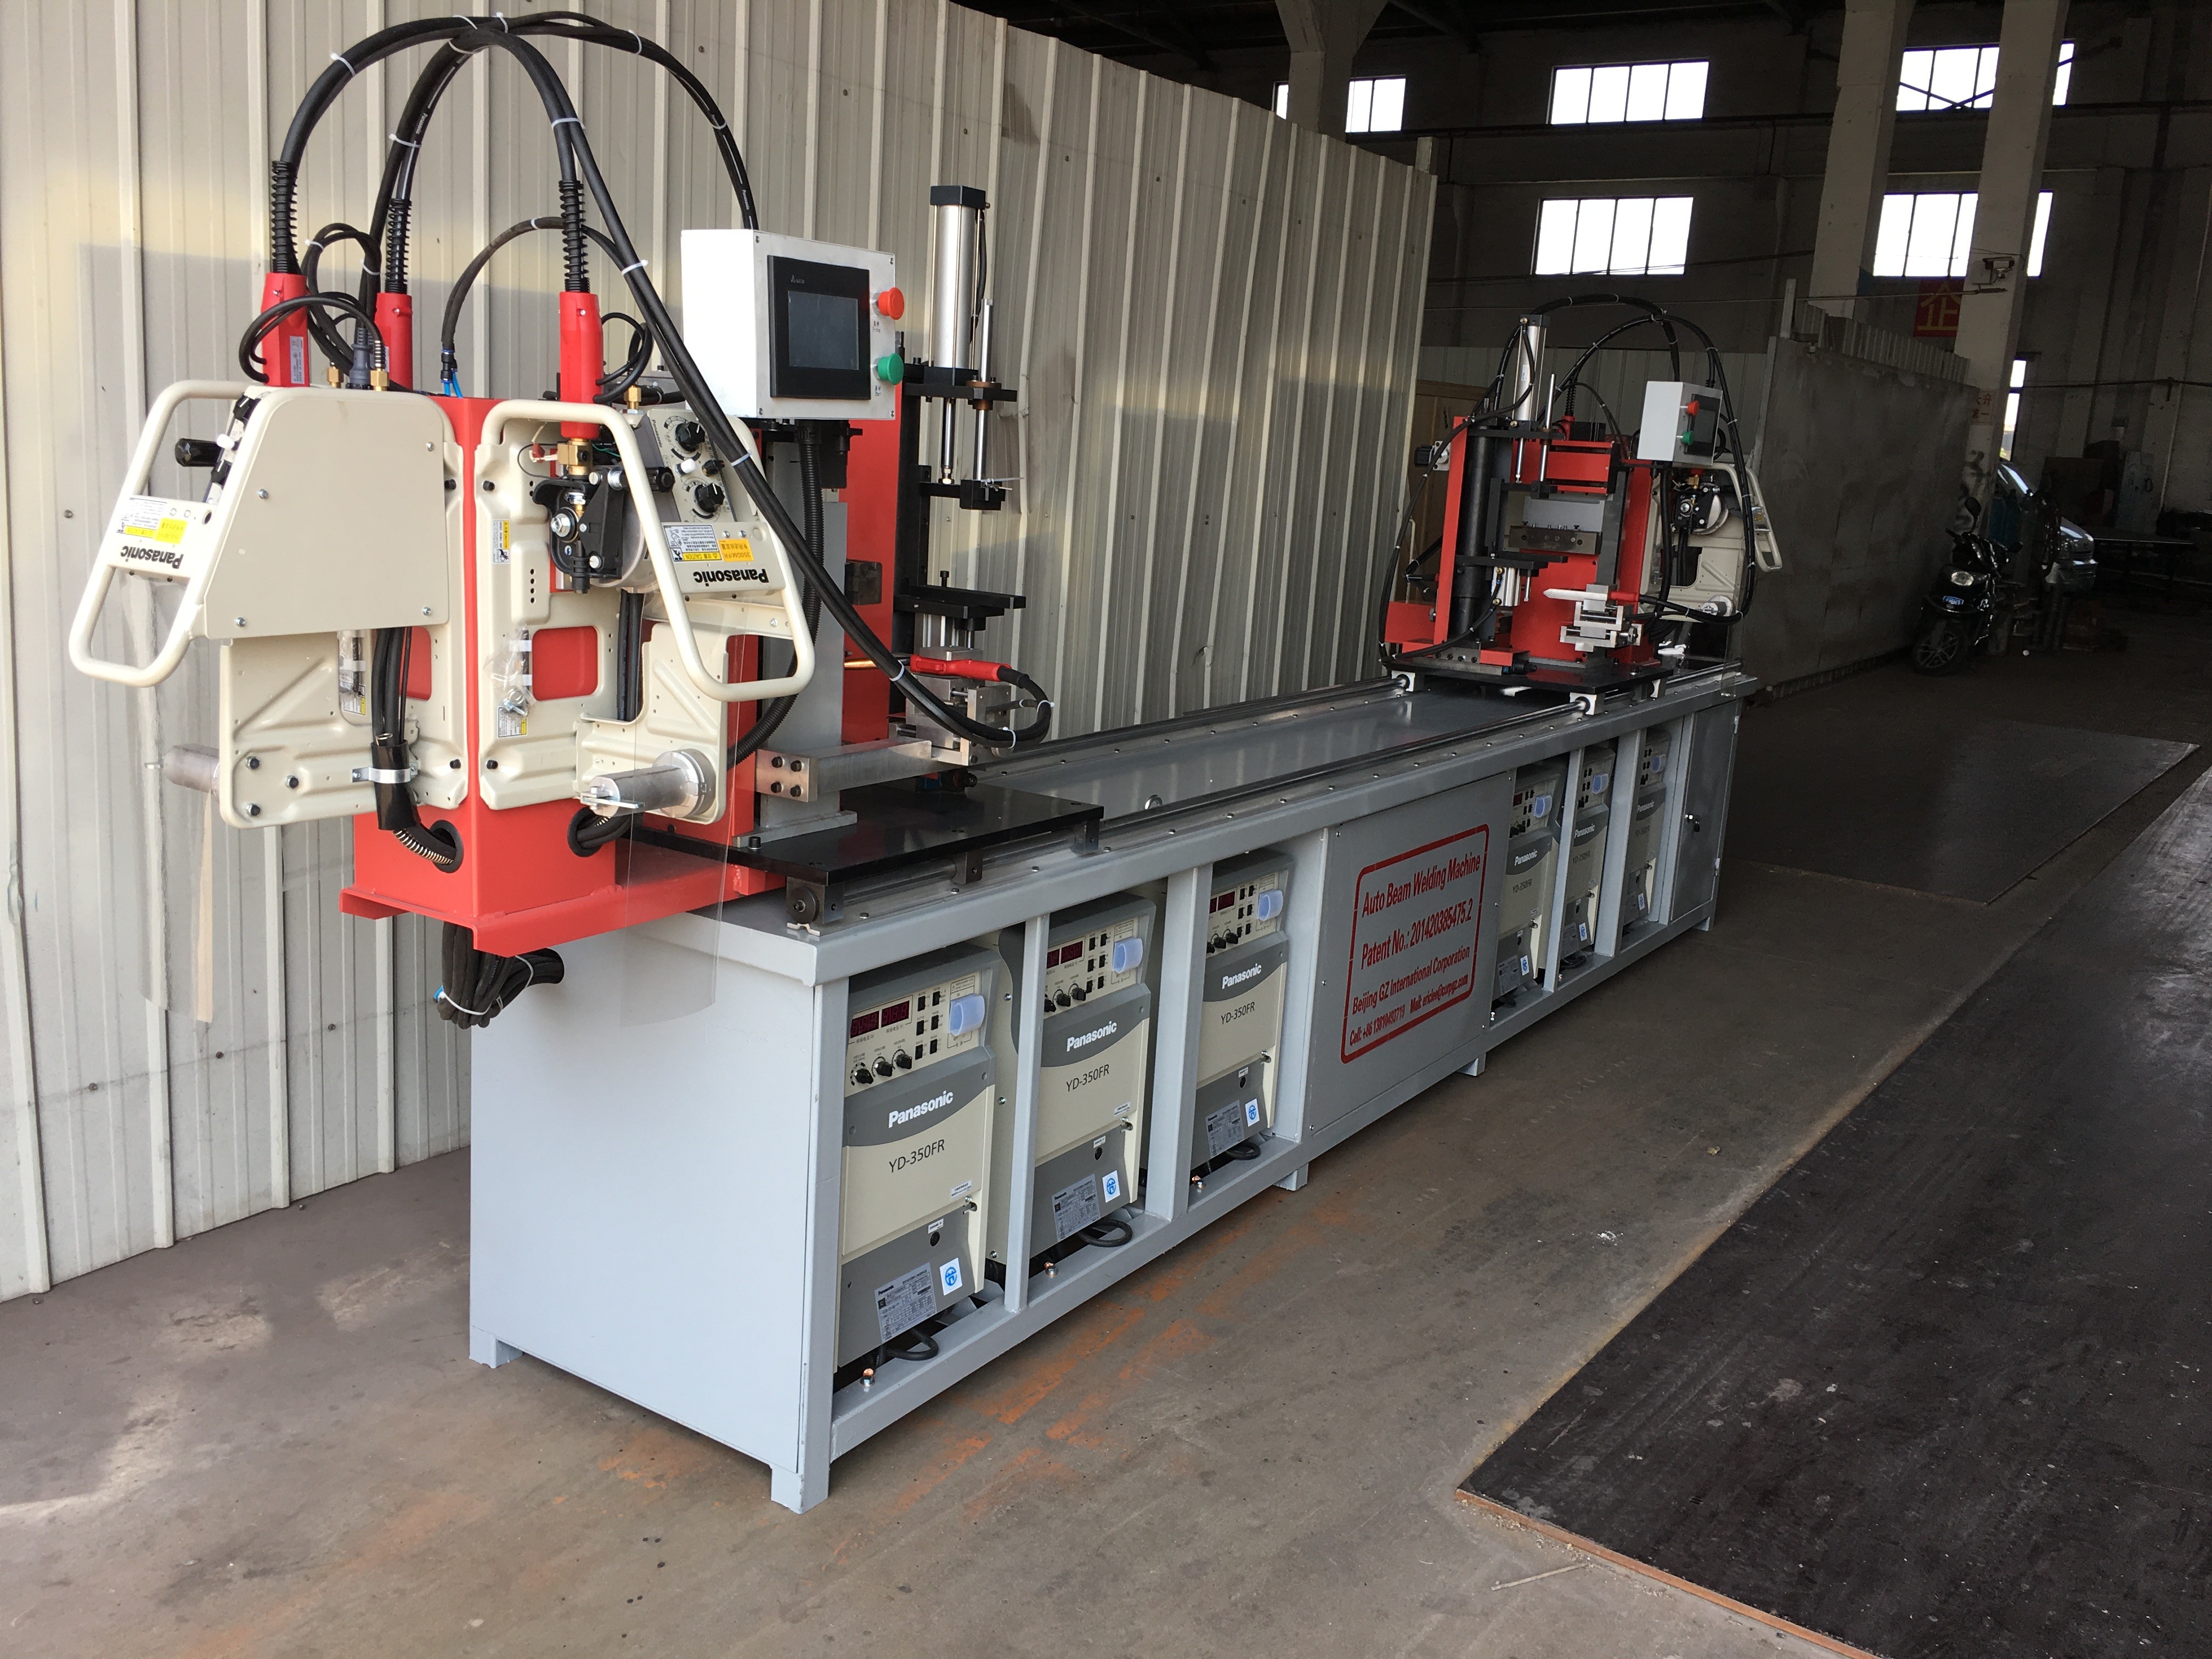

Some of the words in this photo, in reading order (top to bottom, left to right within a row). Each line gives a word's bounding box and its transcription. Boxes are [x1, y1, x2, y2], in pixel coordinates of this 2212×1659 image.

[1918, 279, 1961, 331] 企
[651, 419, 663, 448] Panasonic
[120, 546, 184, 569] Panasonic
[693, 569, 769, 587] Panasonic
[1514, 848, 1538, 866] Panasonic
[1362, 889, 1385, 918] Auto
[1386, 882, 1412, 908] Beam
[1413, 865, 1447, 897] Welding
[1447, 851, 1481, 883] Machine
[1361, 935, 1392, 970] Patent
[1222, 963, 1262, 989] Panasonic
[1352, 990, 1378, 1015] Beijing
[1379, 980, 1390, 1001] GZ
[1390, 959, 1432, 996] International
[1432, 945, 1470, 973] Corporation
[1221, 1001, 1255, 1025] YD-350FR
[1066, 1020, 1118, 1052] Panasonic
[1066, 1064, 1110, 1092] YD-350FR
[888, 1090, 953, 1128] Panasonic
[889, 1139, 945, 1173] YD-350FR
